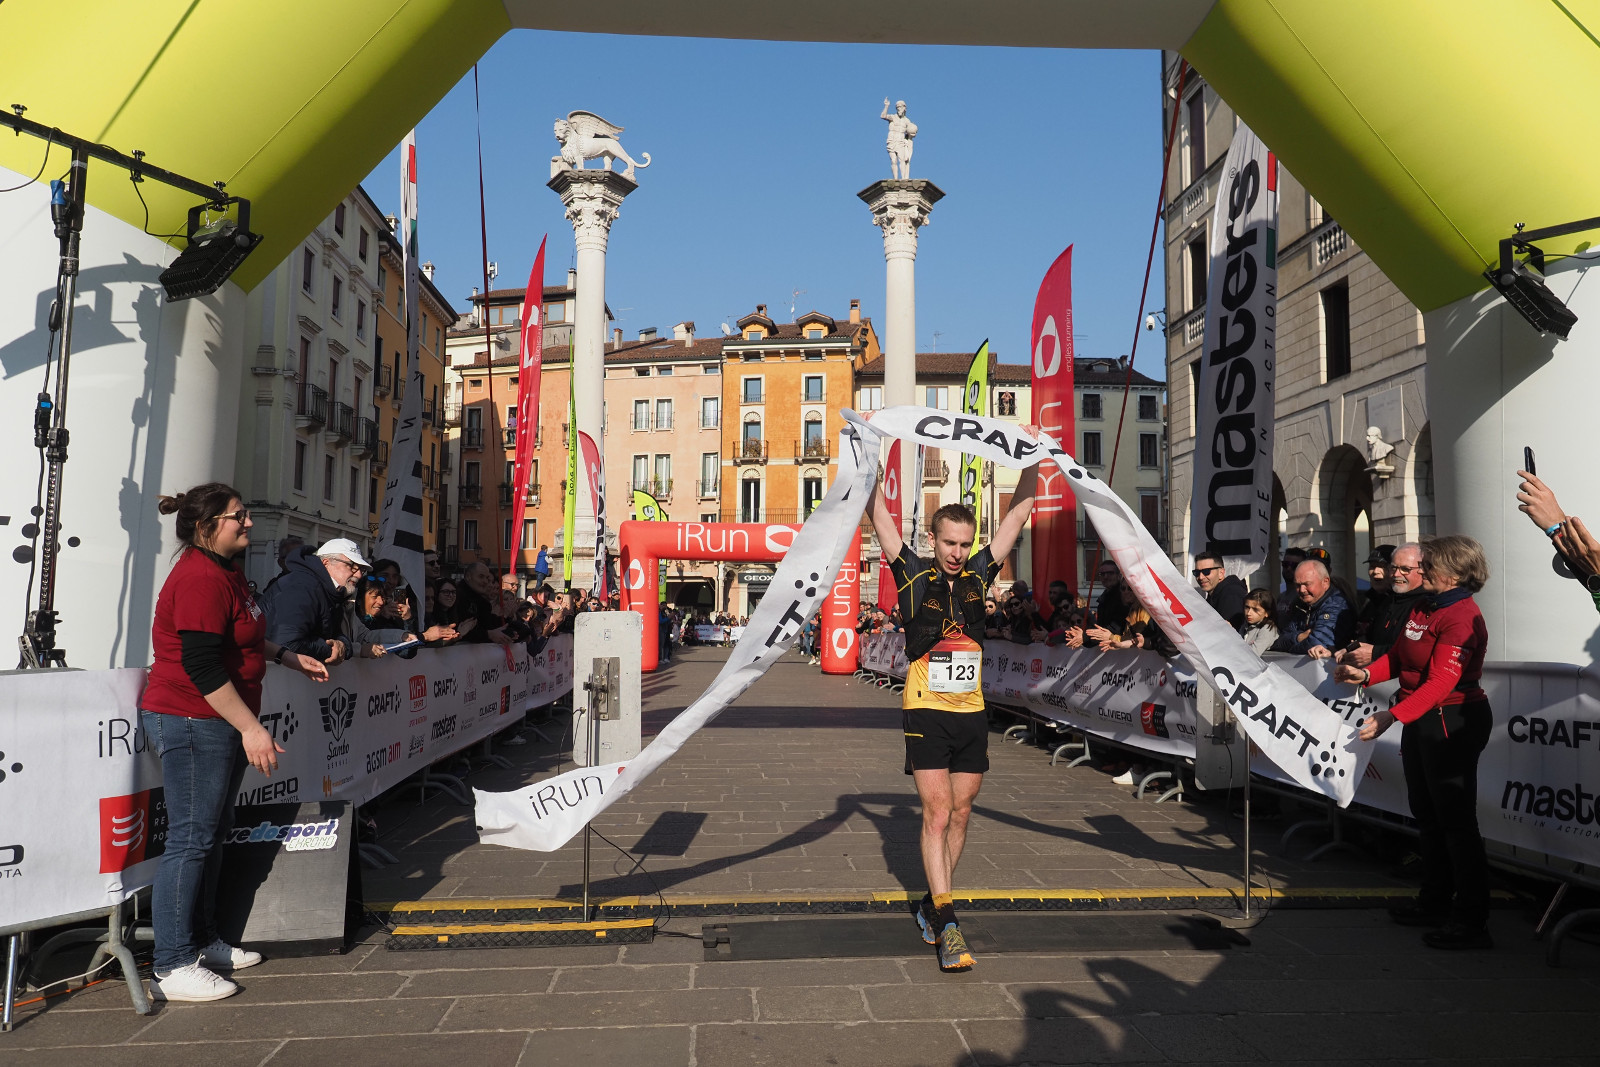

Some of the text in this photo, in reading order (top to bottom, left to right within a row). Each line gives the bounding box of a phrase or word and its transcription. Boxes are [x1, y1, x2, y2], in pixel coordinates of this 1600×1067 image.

[1065, 308, 1073, 341] running
[1263, 283, 1275, 392] ACTION
[1206, 159, 1260, 556] masters
[1259, 428, 1268, 455] IN
[677, 523, 749, 553] iRun
[833, 562, 856, 617] iRun
[482, 668, 496, 685] CRAFT
[946, 664, 975, 681] 123
[1046, 665, 1064, 679] CRAFT
[1101, 671, 1129, 688] CRAFT
[434, 677, 453, 698] CRAFT
[368, 691, 394, 717] CRAFT
[1099, 707, 1132, 722] OLIVIERO
[1211, 666, 1320, 758] CRAFT
[98, 718, 150, 758] iRu
[388, 741, 400, 764] aim
[529, 776, 604, 820] iRun
[1503, 813, 1523, 824] LIFE
[1534, 819, 1546, 828] IN
